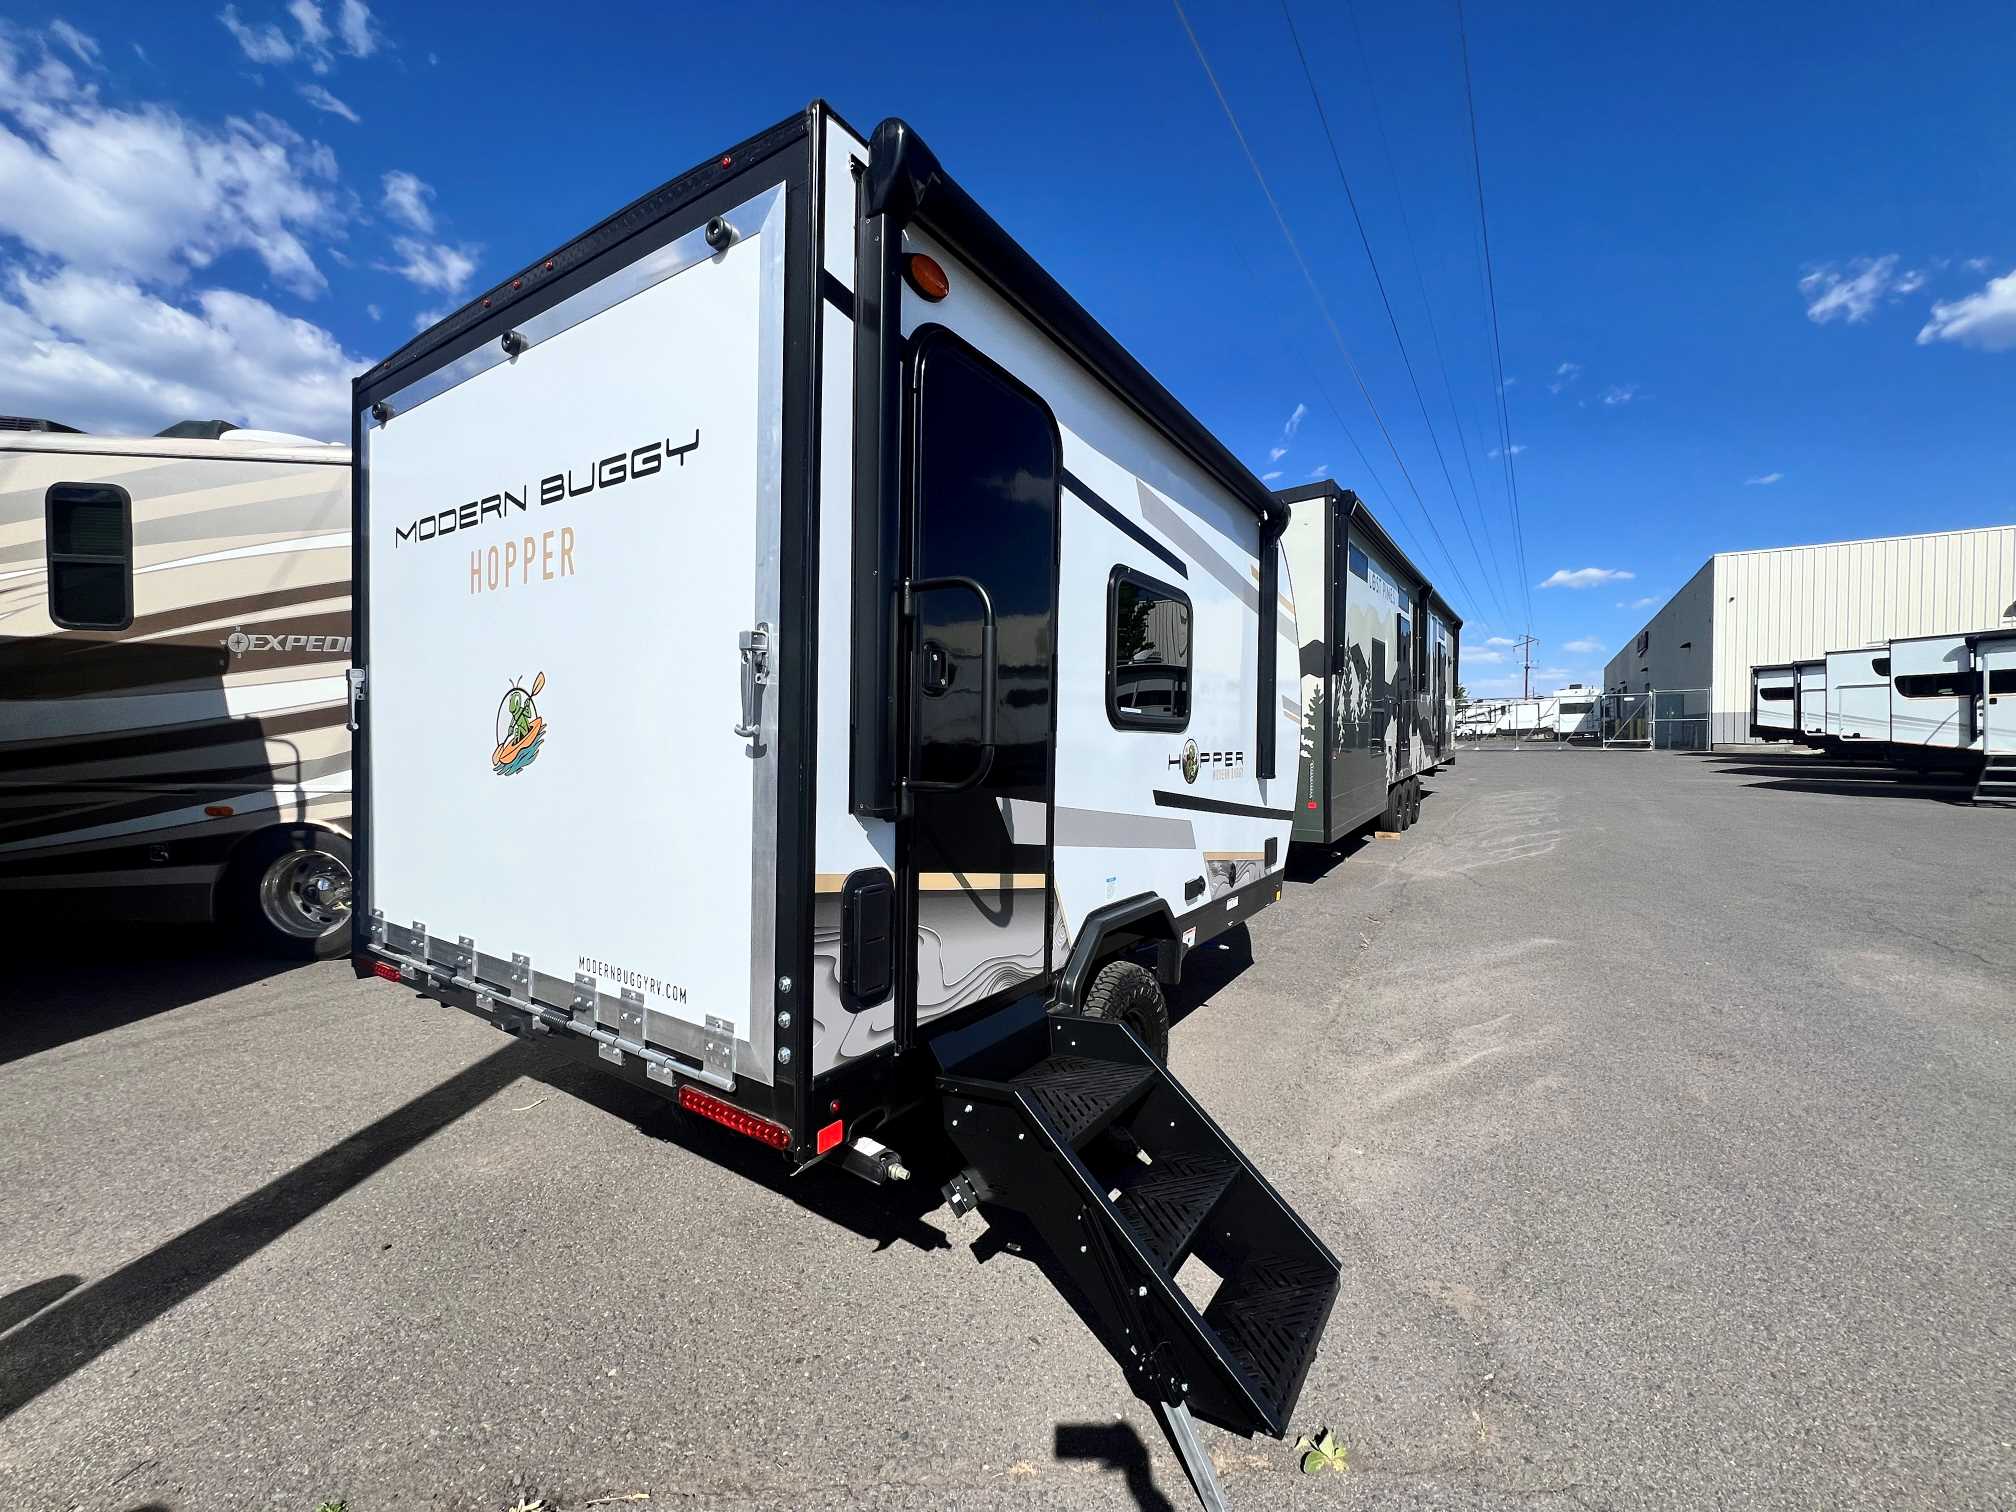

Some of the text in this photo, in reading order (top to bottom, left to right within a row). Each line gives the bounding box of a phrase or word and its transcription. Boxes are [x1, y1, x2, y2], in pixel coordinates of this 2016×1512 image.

[395, 428, 700, 549] MODERN BUGGY
[470, 526, 575, 594] HOPPER
[578, 955, 687, 1004] MODERNBUGGYRV.COM
